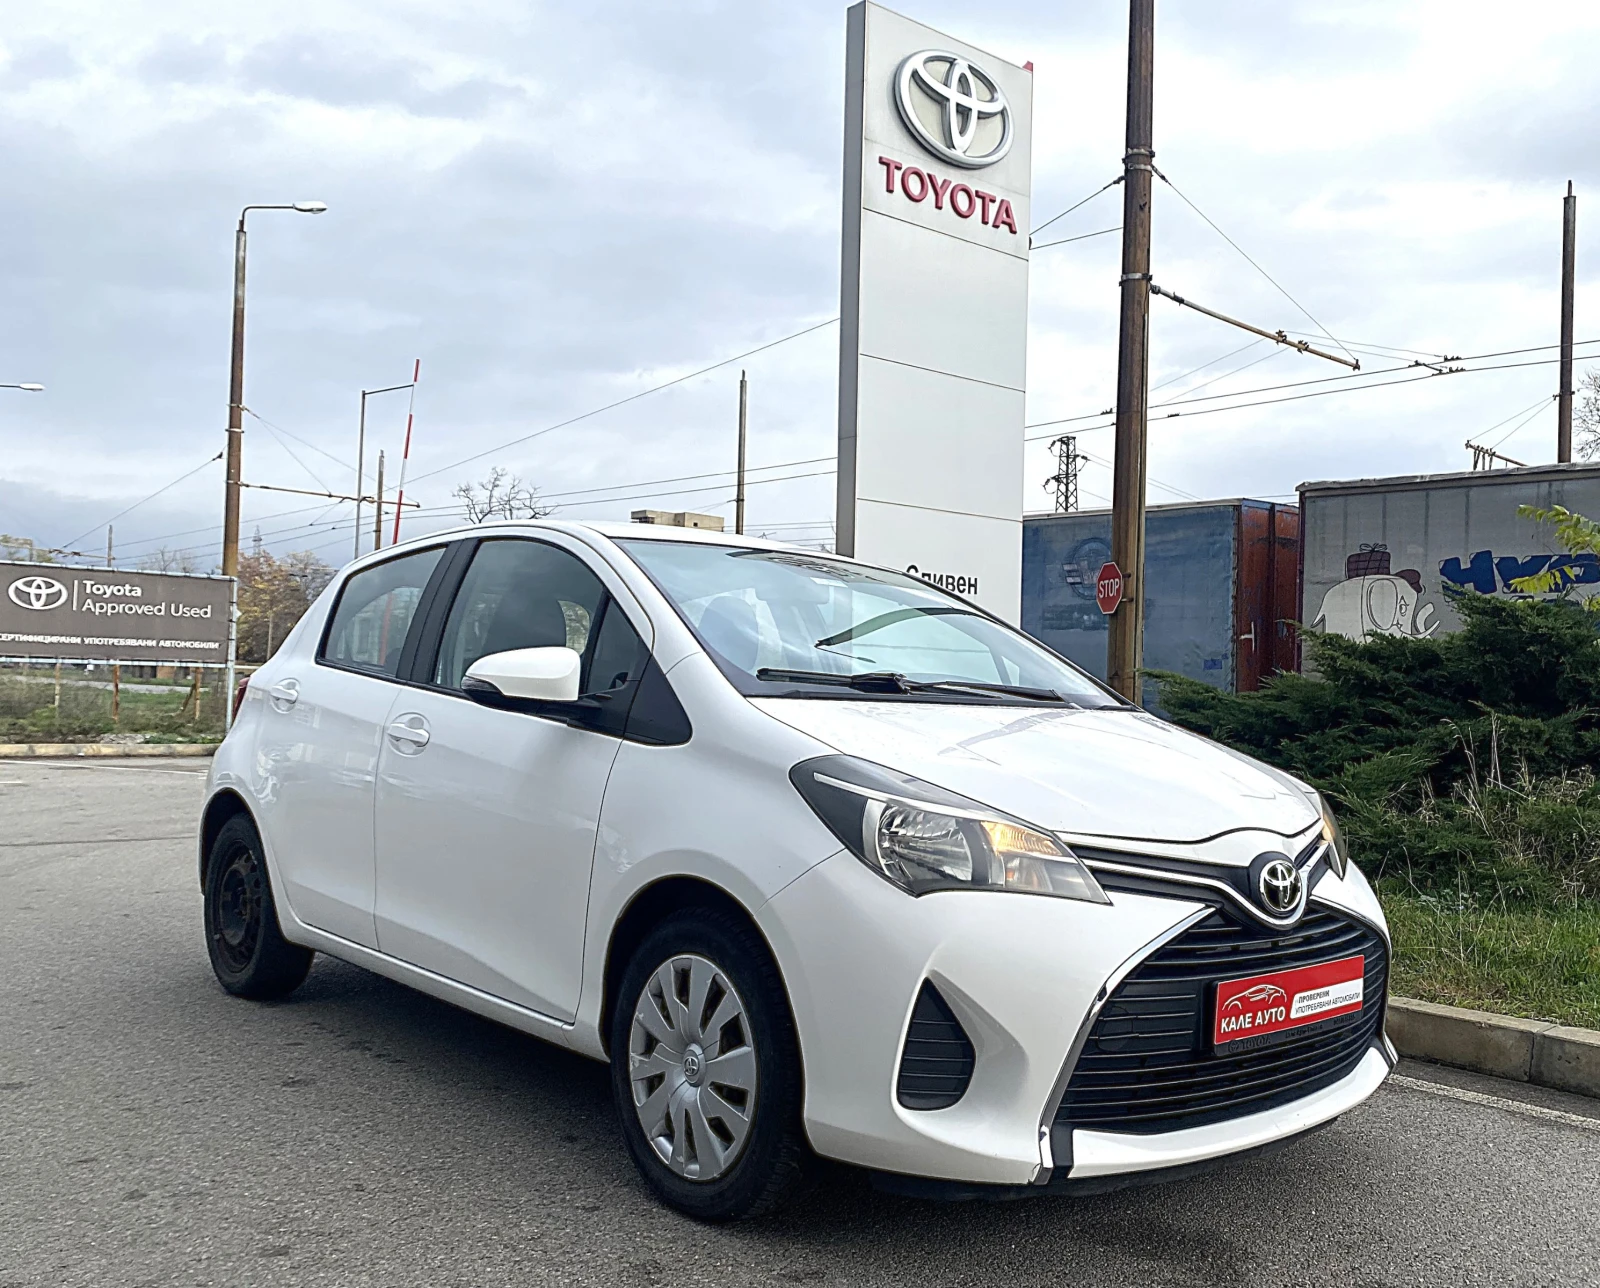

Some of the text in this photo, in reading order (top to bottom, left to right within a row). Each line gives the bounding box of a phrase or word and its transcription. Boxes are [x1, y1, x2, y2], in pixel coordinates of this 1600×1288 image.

[878, 156, 1017, 235] TOYOTA
[82, 580, 142, 597] Toyota
[1098, 578, 1120, 598] STOP
[81, 599, 212, 618] Approved Used
[83, 637, 156, 647] УПОТРЕБЯВАНИ
[158, 639, 219, 649] АВТОМОБИЛИ
[1298, 989, 1330, 1003] ПРОВЕРЕНИ
[1220, 1006, 1286, 1034] КАЛЕ АУТО
